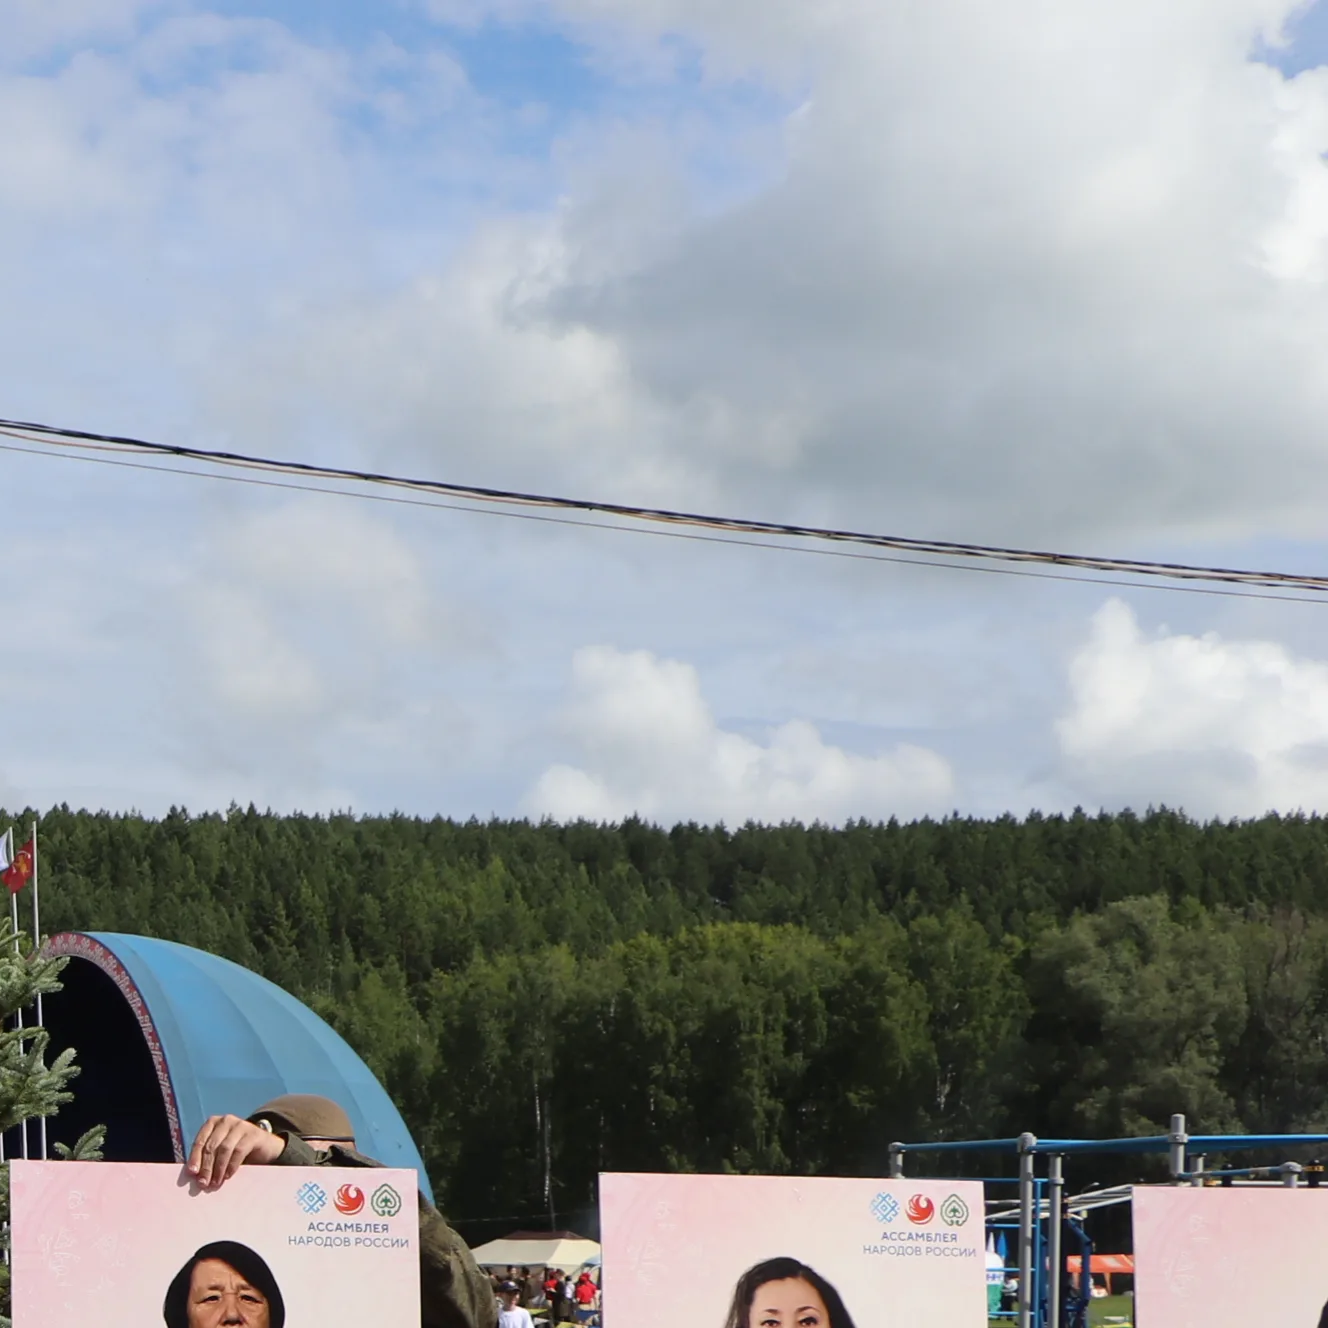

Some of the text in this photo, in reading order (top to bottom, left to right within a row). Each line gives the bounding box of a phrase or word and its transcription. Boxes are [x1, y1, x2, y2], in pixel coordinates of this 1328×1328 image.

[307, 1221, 389, 1234] АССАМБЛЕЯ
[288, 1235, 409, 1249] НАРОДОВ РОССИИ
[881, 1231, 958, 1243] АССАМБЛЕЯ
[863, 1244, 976, 1258] НАРОДОВ РОССИИ
